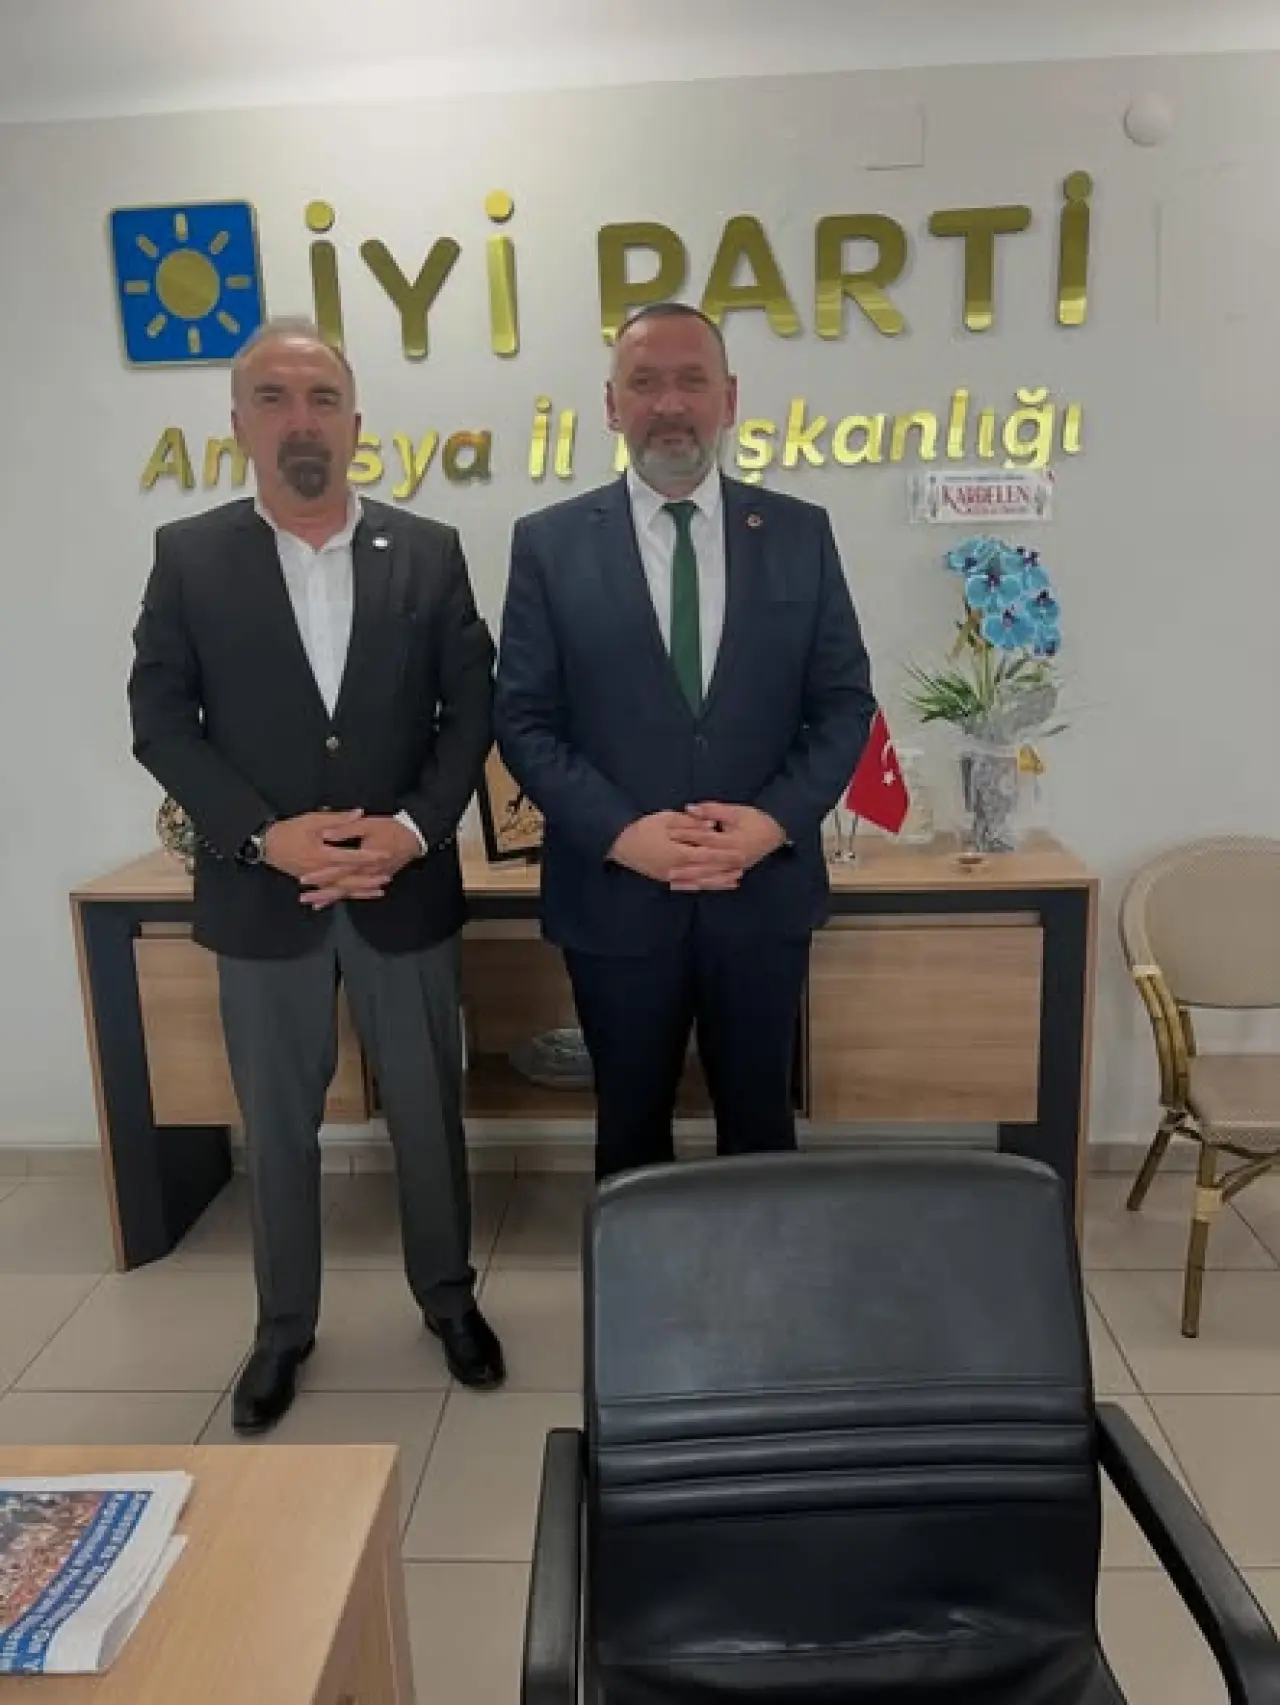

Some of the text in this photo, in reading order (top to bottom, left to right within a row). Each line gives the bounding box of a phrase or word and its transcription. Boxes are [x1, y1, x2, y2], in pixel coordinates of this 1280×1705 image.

[303, 169, 1093, 358] İYİ PARTİ
[141, 426, 492, 498] Amsya
[612, 386, 1083, 485] şkanlığı
